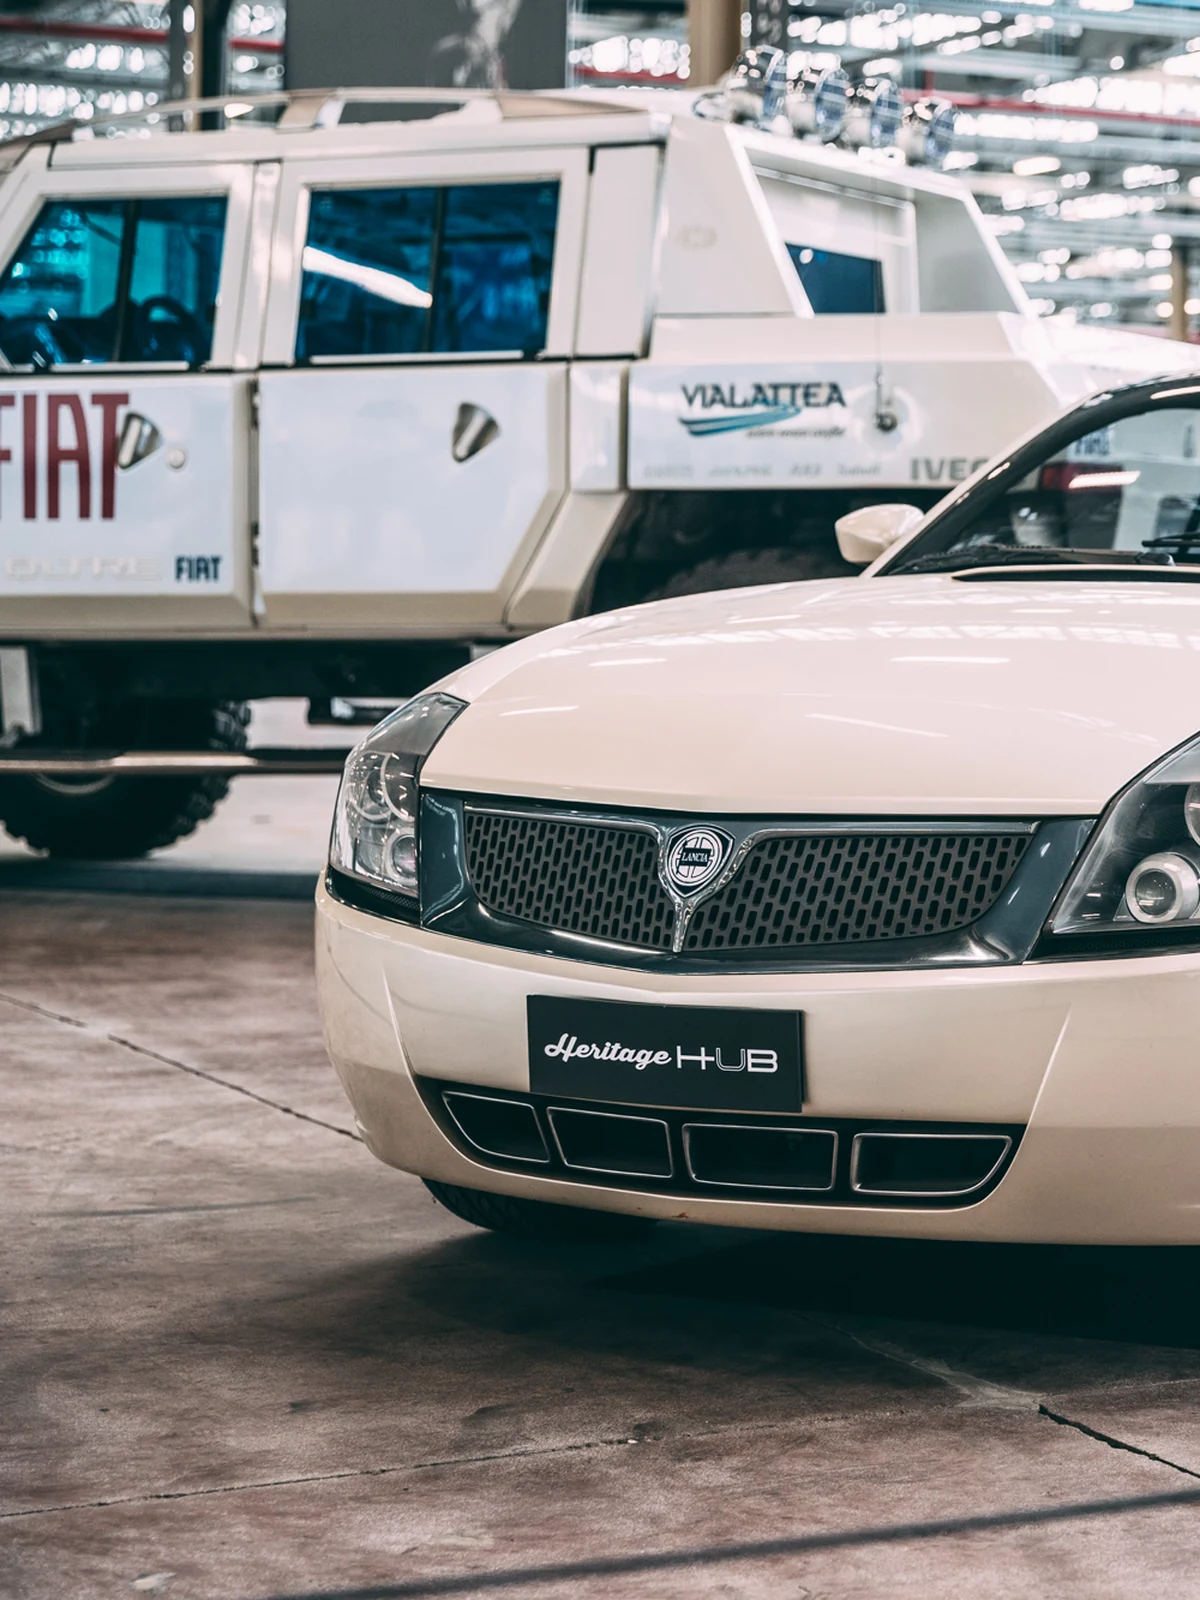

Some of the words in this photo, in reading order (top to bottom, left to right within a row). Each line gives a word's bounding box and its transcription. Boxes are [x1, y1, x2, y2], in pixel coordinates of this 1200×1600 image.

[680, 381, 848, 409] VIALATTEA
[174, 556, 223, 582] FIAT
[680, 851, 709, 863] LANCIA
[544, 1032, 673, 1071] Heritage
[676, 1045, 779, 1073] HUB
